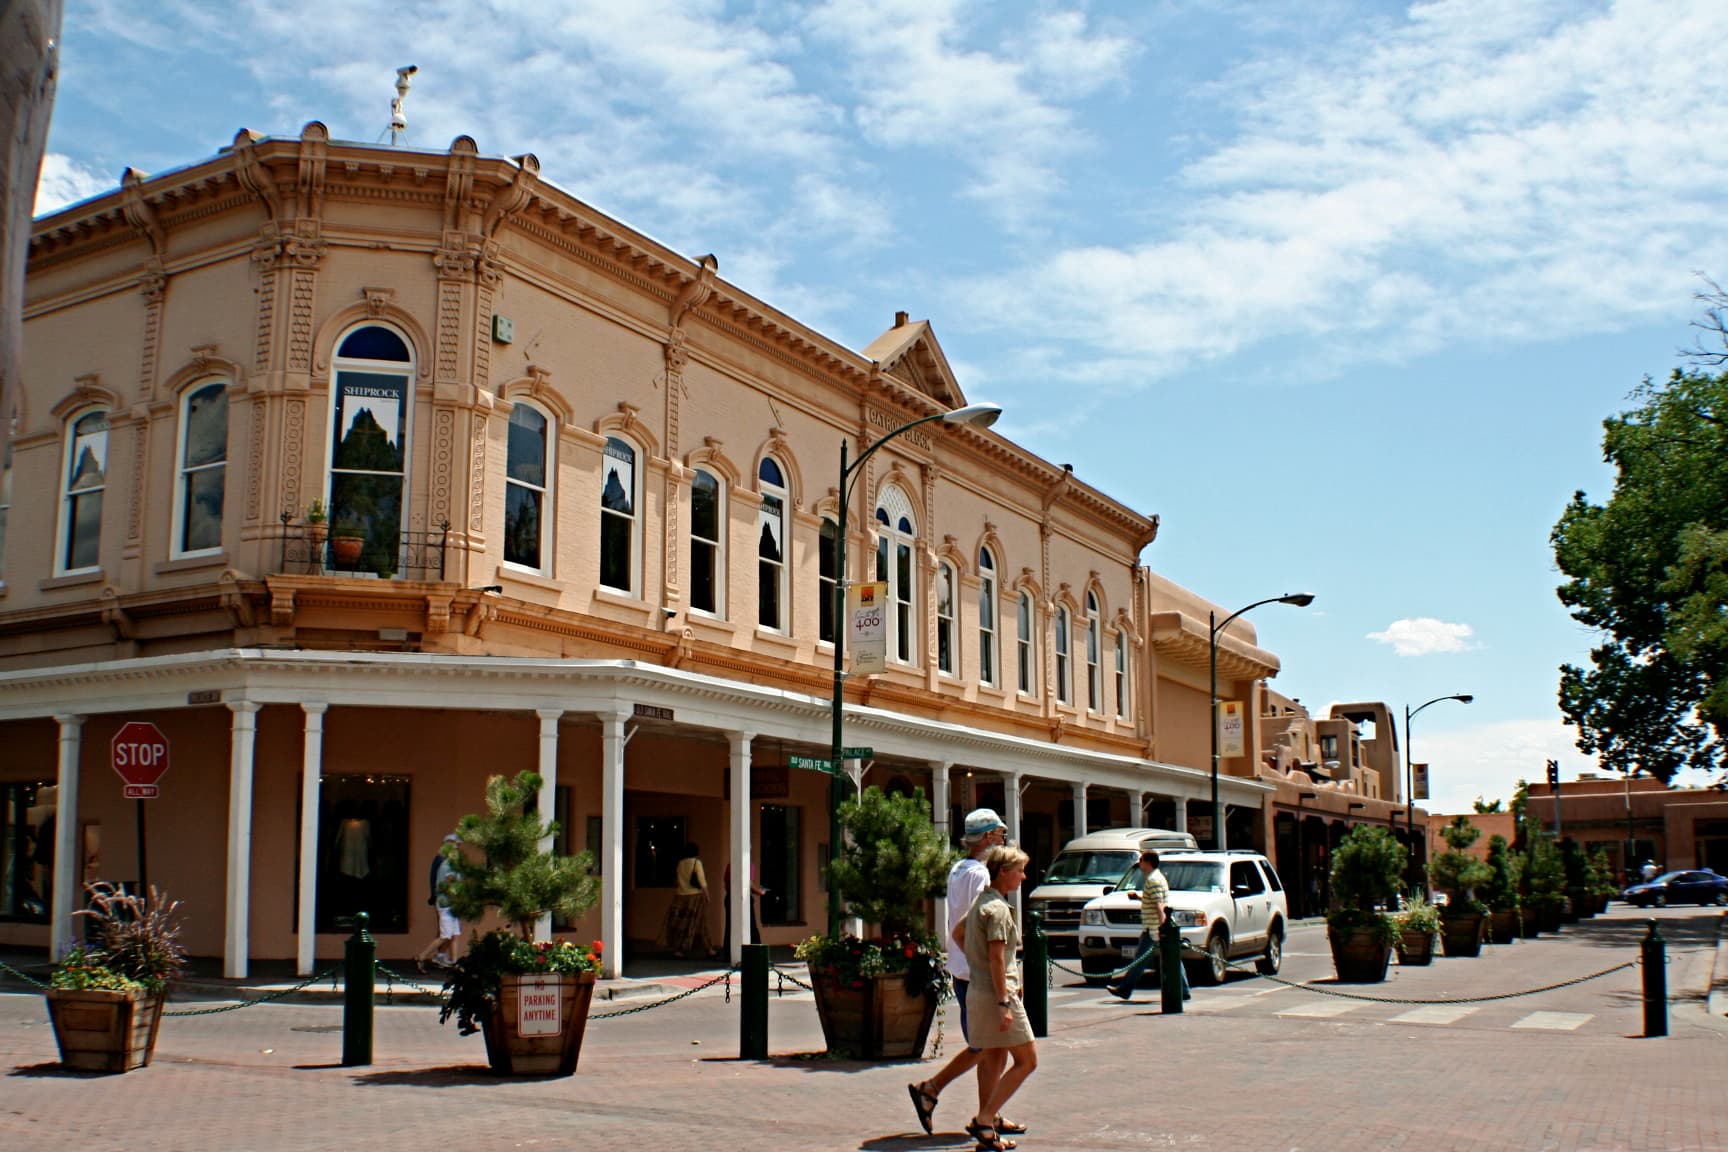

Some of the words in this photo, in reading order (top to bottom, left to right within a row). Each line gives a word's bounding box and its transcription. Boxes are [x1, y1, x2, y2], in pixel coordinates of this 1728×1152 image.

[344, 386, 400, 398] SHIPROCK
[856, 618, 880, 631] 400
[116, 743, 165, 766] STOP
[799, 759, 814, 770] SANTA
[815, 761, 822, 771] FE
[524, 995, 556, 1006] PARKING
[524, 1010, 556, 1021] ANYTIME
